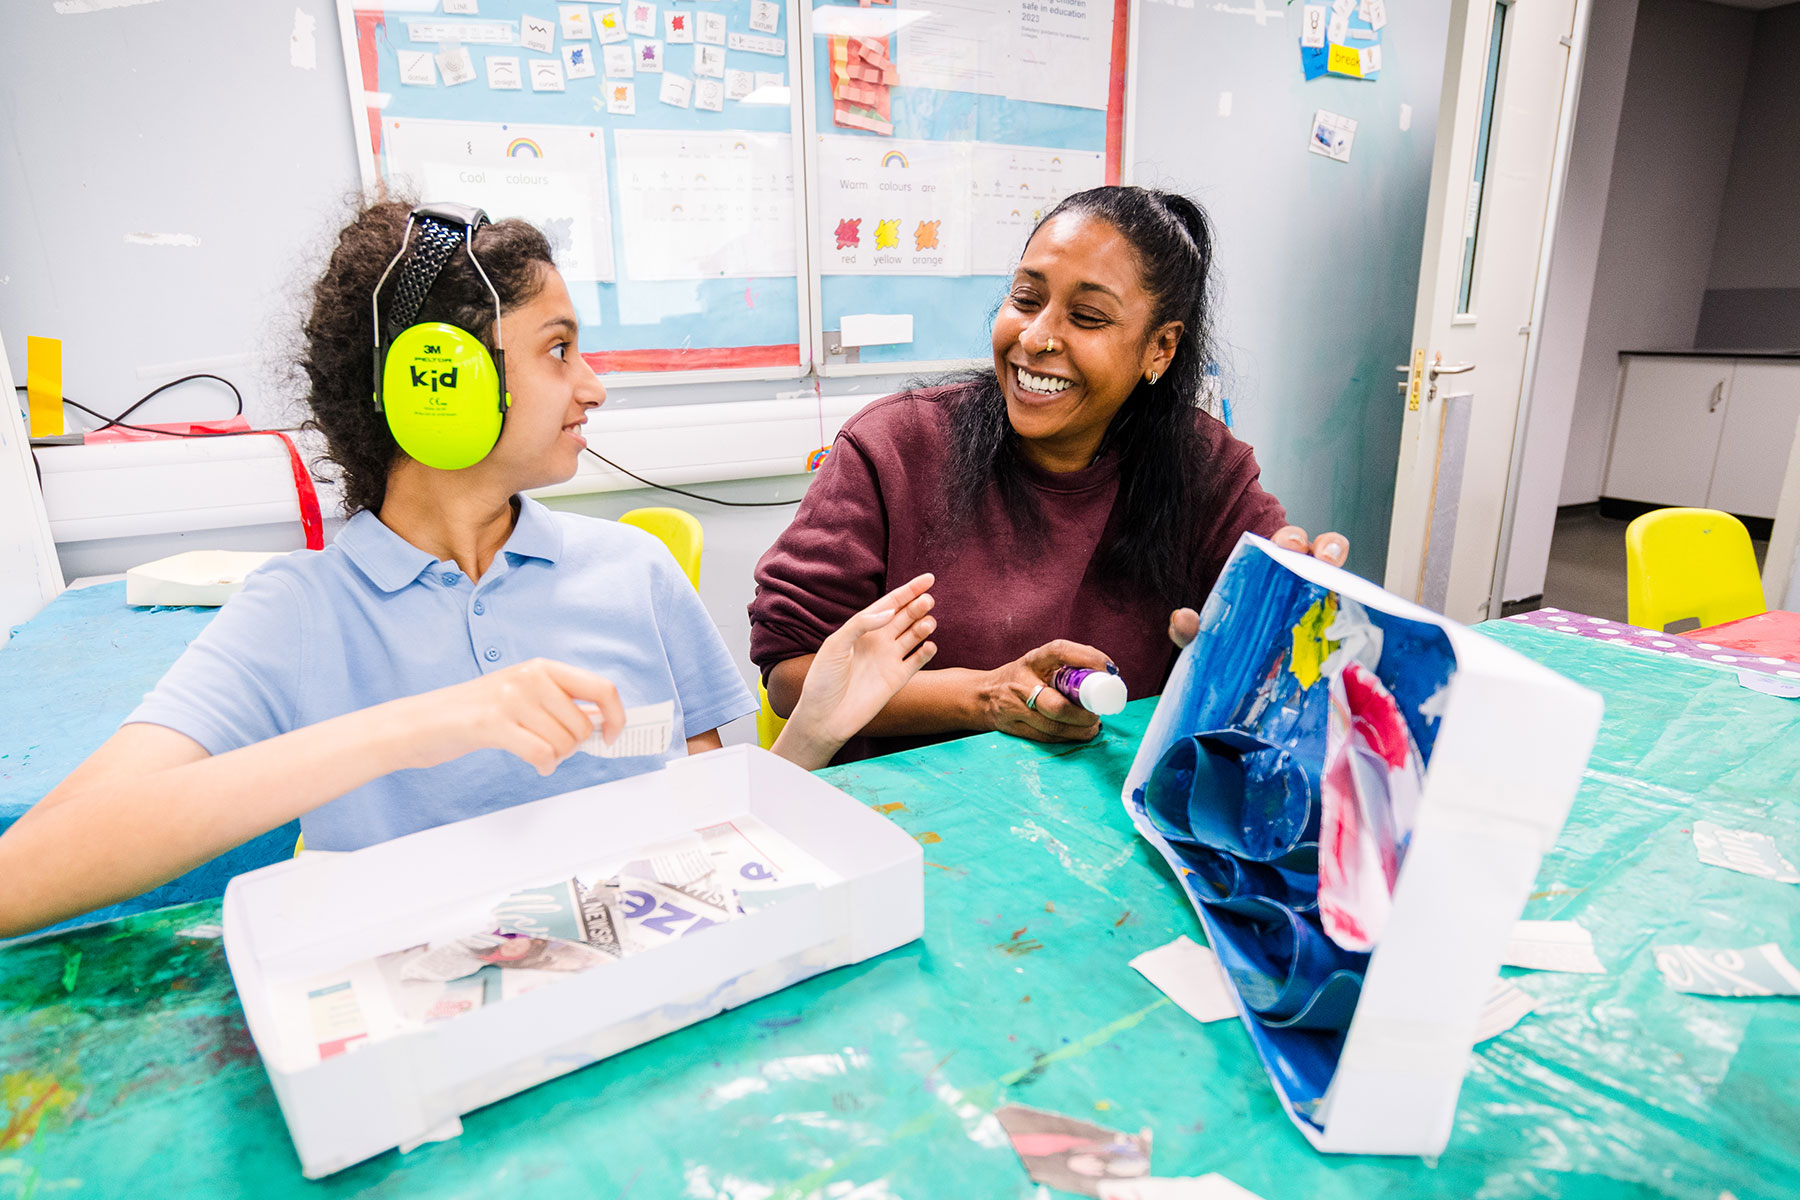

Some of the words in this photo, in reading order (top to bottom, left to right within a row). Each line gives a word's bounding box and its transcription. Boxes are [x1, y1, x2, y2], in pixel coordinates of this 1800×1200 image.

[1022, 2, 1039, 11] safe
[1040, 4, 1048, 12] in
[1049, 6, 1087, 19] education
[1021, 12, 1040, 23] 2023
[459, 171, 486, 184] Cool
[506, 172, 549, 185] colours
[840, 180, 868, 191] Warm
[879, 180, 912, 192] colours
[922, 183, 936, 193] are
[841, 254, 856, 264] red
[873, 254, 902, 266] yellow
[912, 255, 943, 266] orange
[423, 345, 441, 354] 3M
[410, 365, 458, 392] kid
